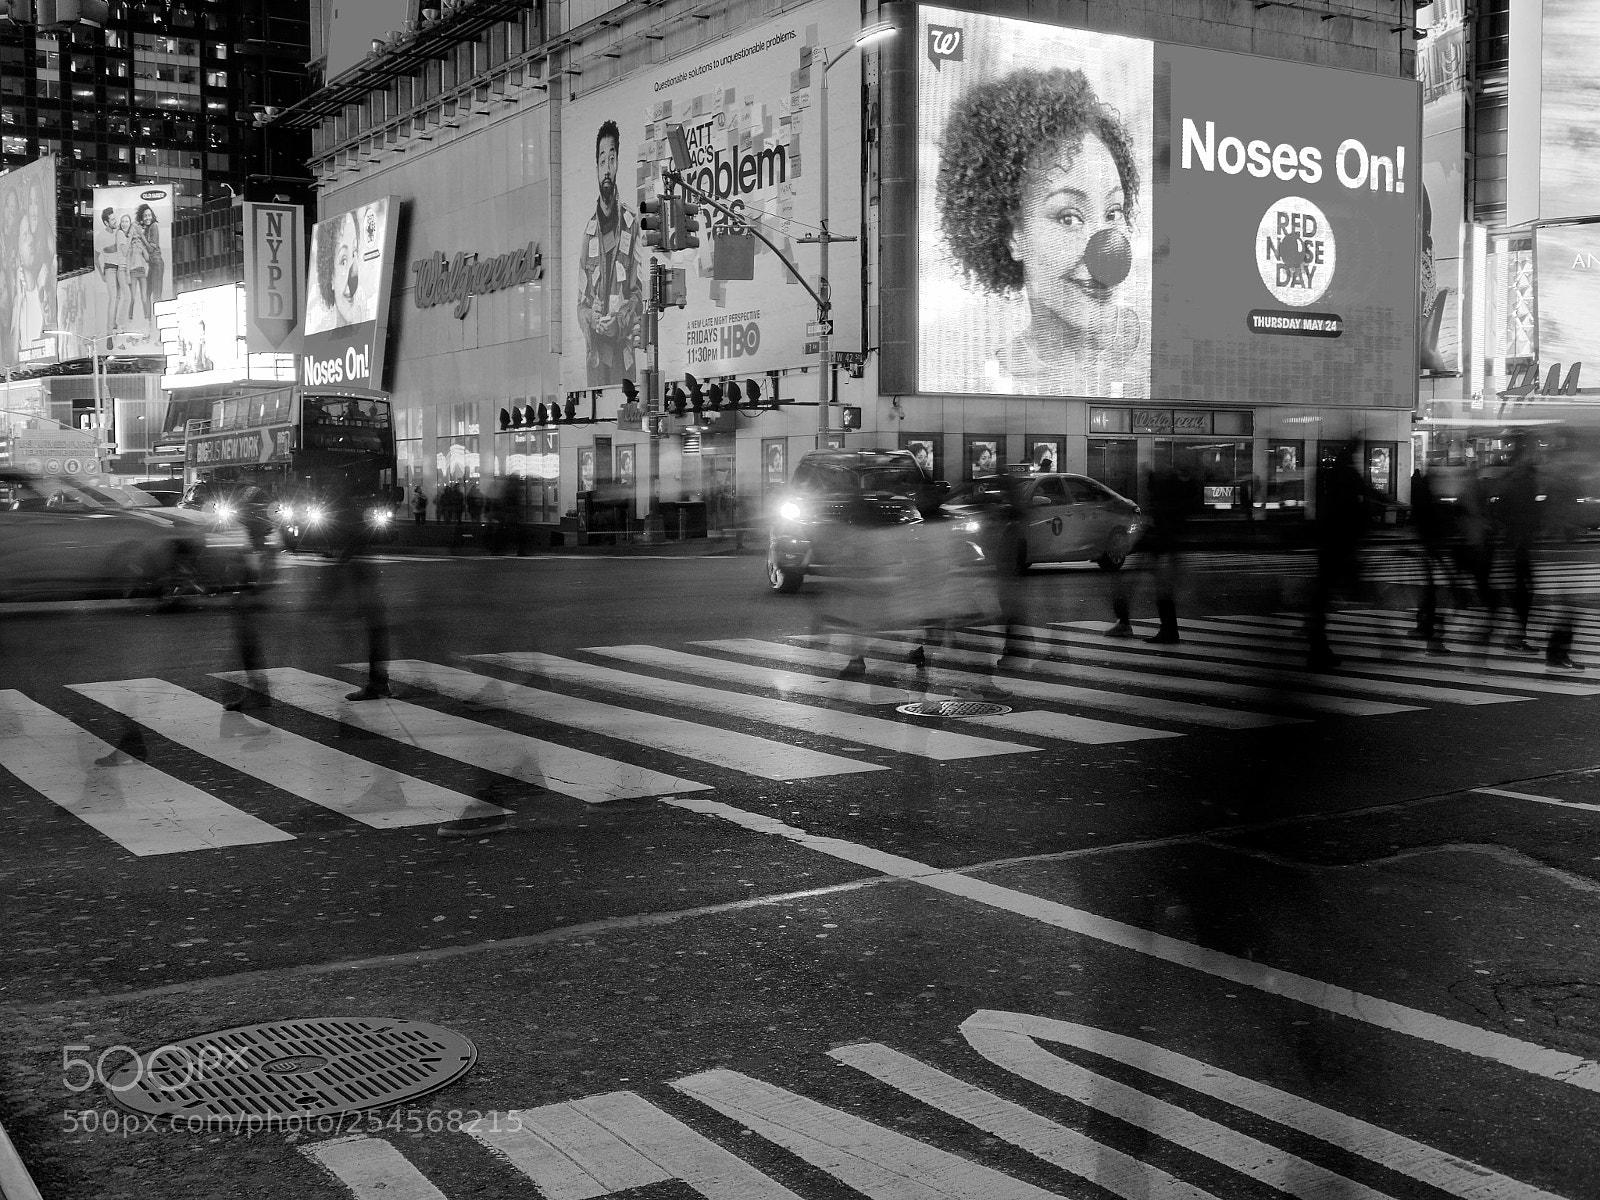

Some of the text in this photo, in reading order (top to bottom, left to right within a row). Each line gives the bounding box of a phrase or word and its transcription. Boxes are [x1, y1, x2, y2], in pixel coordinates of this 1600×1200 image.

[653, 29, 797, 92] Questionable solutions to unquestionable problems.
[1181, 117, 1405, 194] Noses On!
[1276, 211, 1318, 238] RED
[265, 212, 283, 317] NYPD
[412, 241, 540, 319] Walgreens
[1275, 263, 1317, 289] DAY
[1252, 315, 1337, 332] THURSDAY MAY 24
[687, 321, 761, 360] FRIDAYS HBO
[687, 346, 718, 364] 11:30PM
[304, 344, 370, 387] Noses On!
[836, 353, 843, 362] W
[845, 353, 854, 363] 42
[221, 438, 238, 460] NEW
[238, 435, 260, 458] YORK
